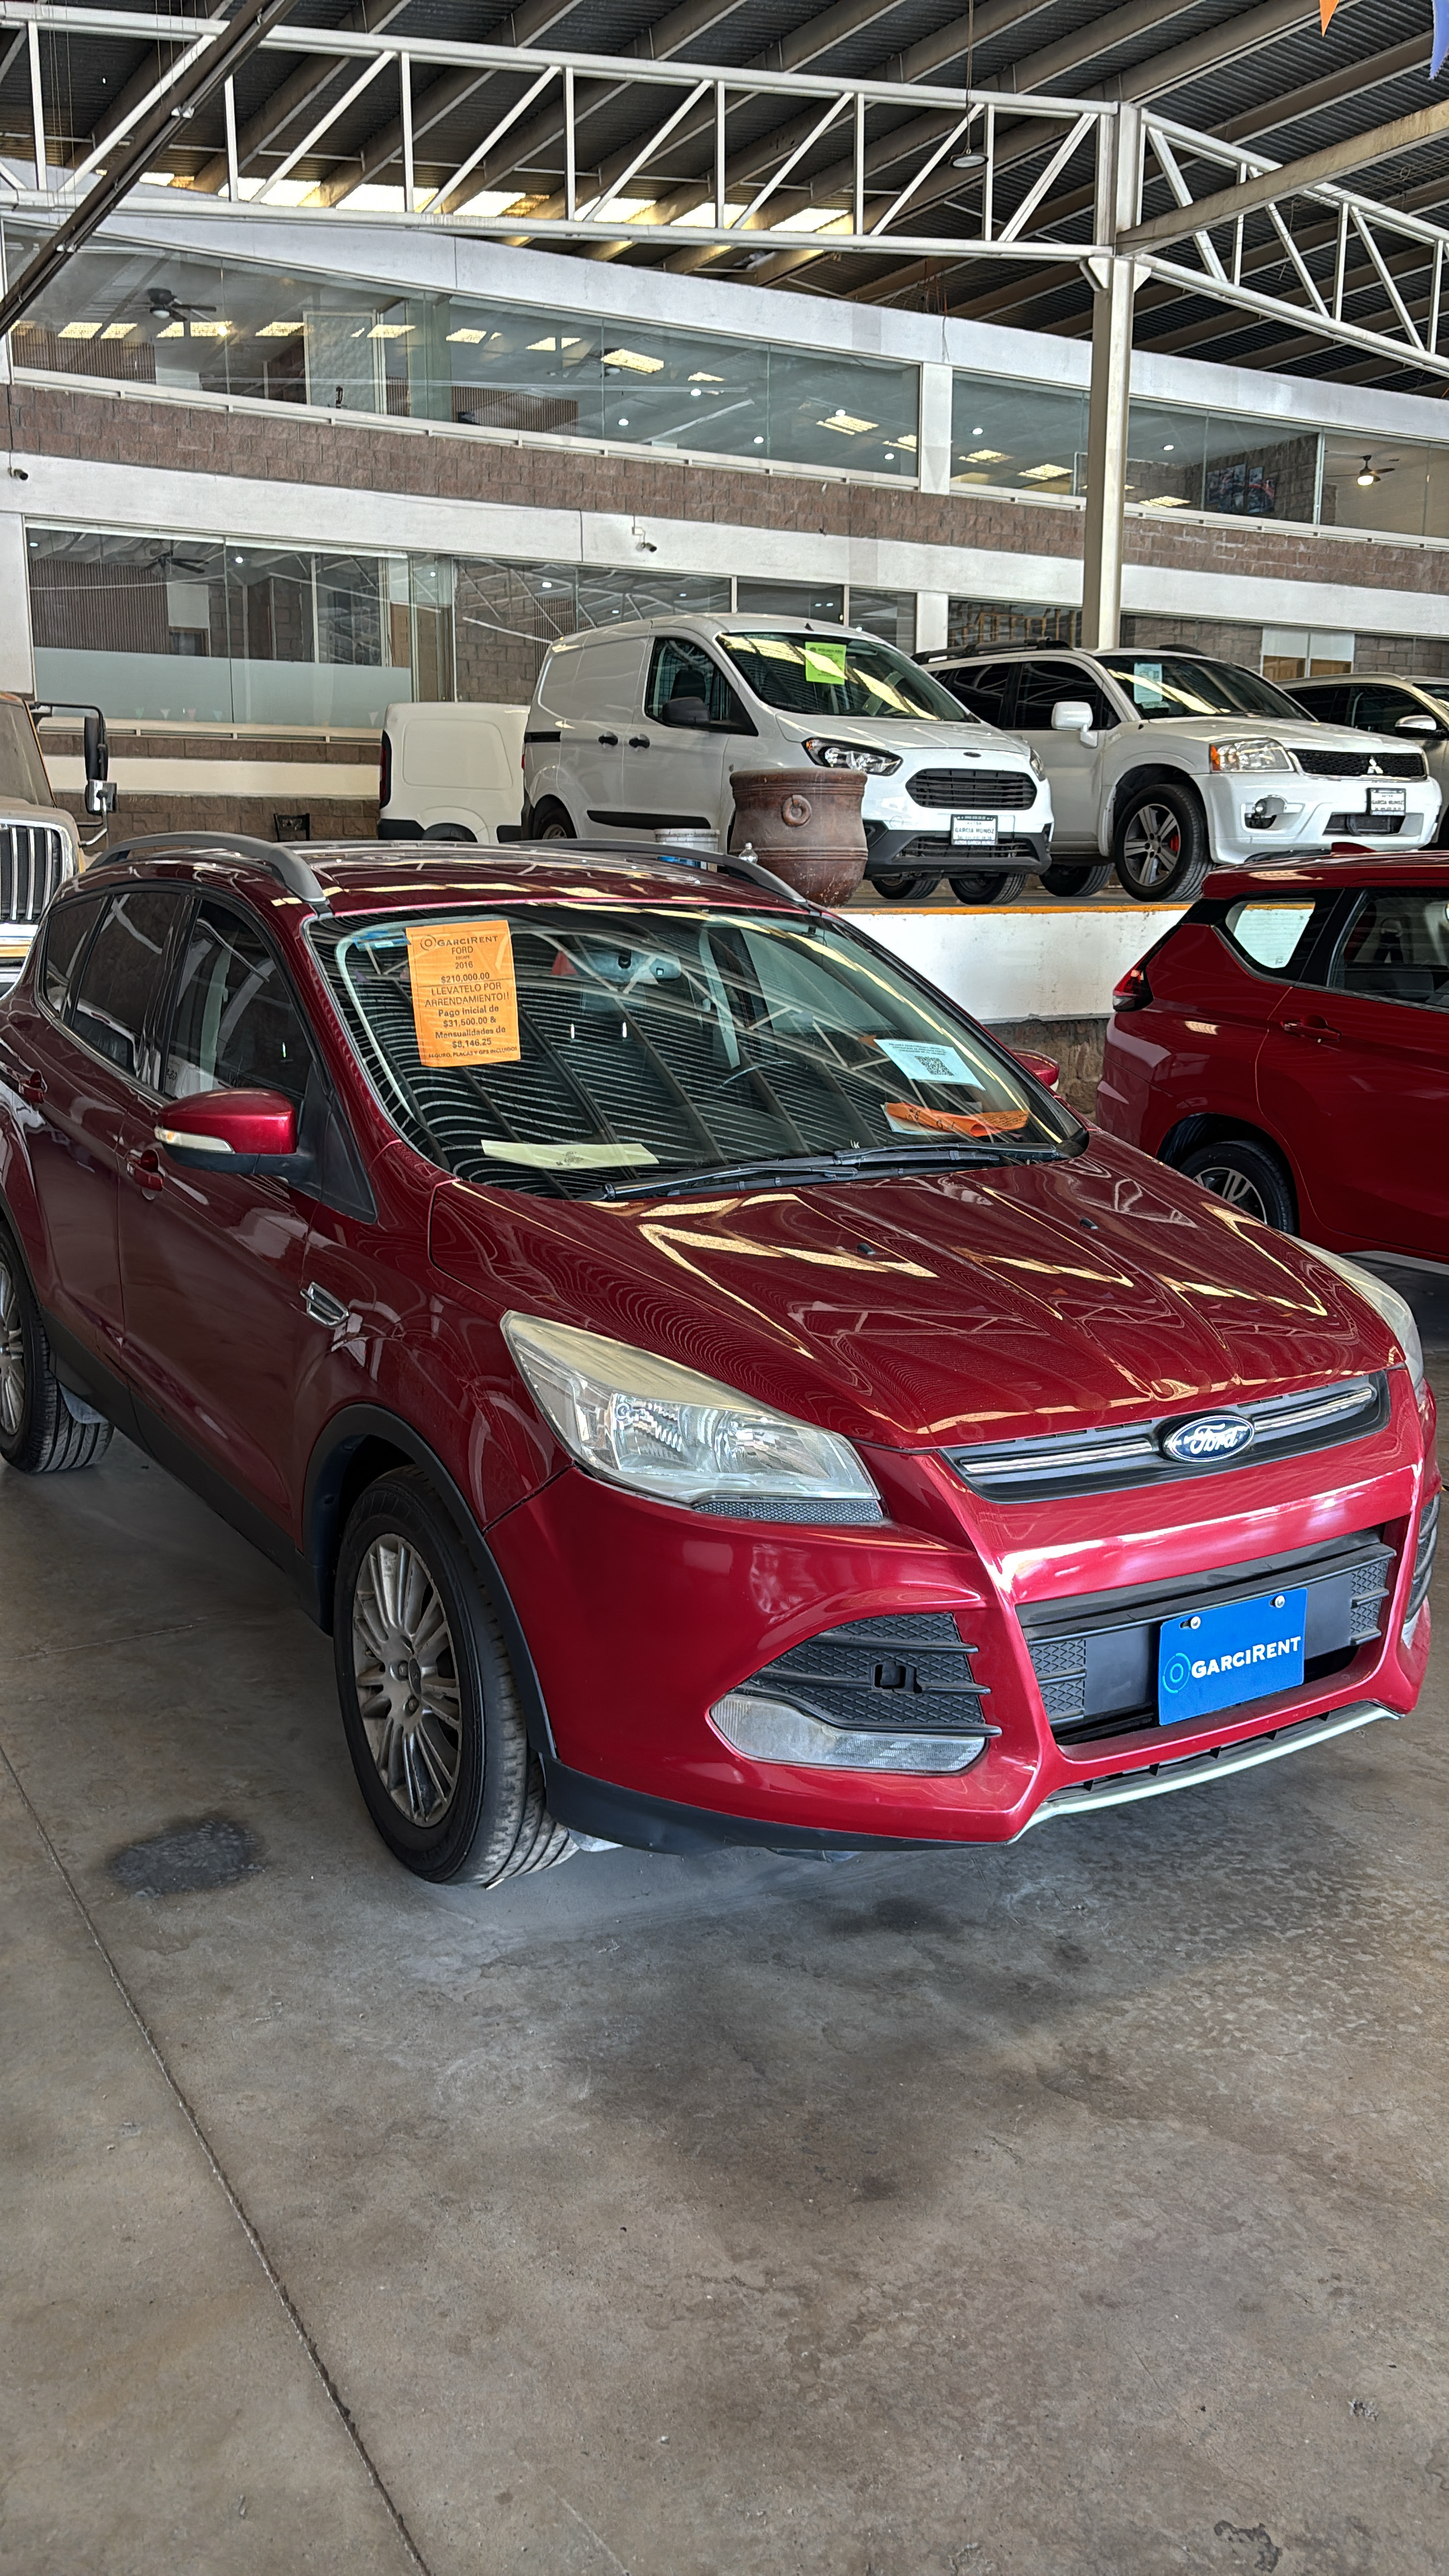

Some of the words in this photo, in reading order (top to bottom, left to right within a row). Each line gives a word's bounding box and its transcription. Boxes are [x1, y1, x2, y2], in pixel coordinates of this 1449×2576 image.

[437, 935, 498, 947] GARCIRENT
[451, 946, 474, 955] FORD
[455, 961, 474, 970] 2016
[441, 971, 490, 984] $210,000.00
[431, 983, 482, 996] LLEVATELO
[483, 981, 502, 991] POR
[438, 1009, 460, 1018] Pago
[488, 1004, 499, 1012] de
[443, 1016, 488, 1028] $31,500.00
[490, 1016, 496, 1024] &
[435, 1028, 494, 1039] Mensualidades
[495, 1026, 506, 1034] de
[452, 1038, 492, 1049] $8,146.25
[1183, 1423, 1249, 1454] Ford
[1191, 1635, 1301, 1679] GARCIRENT
